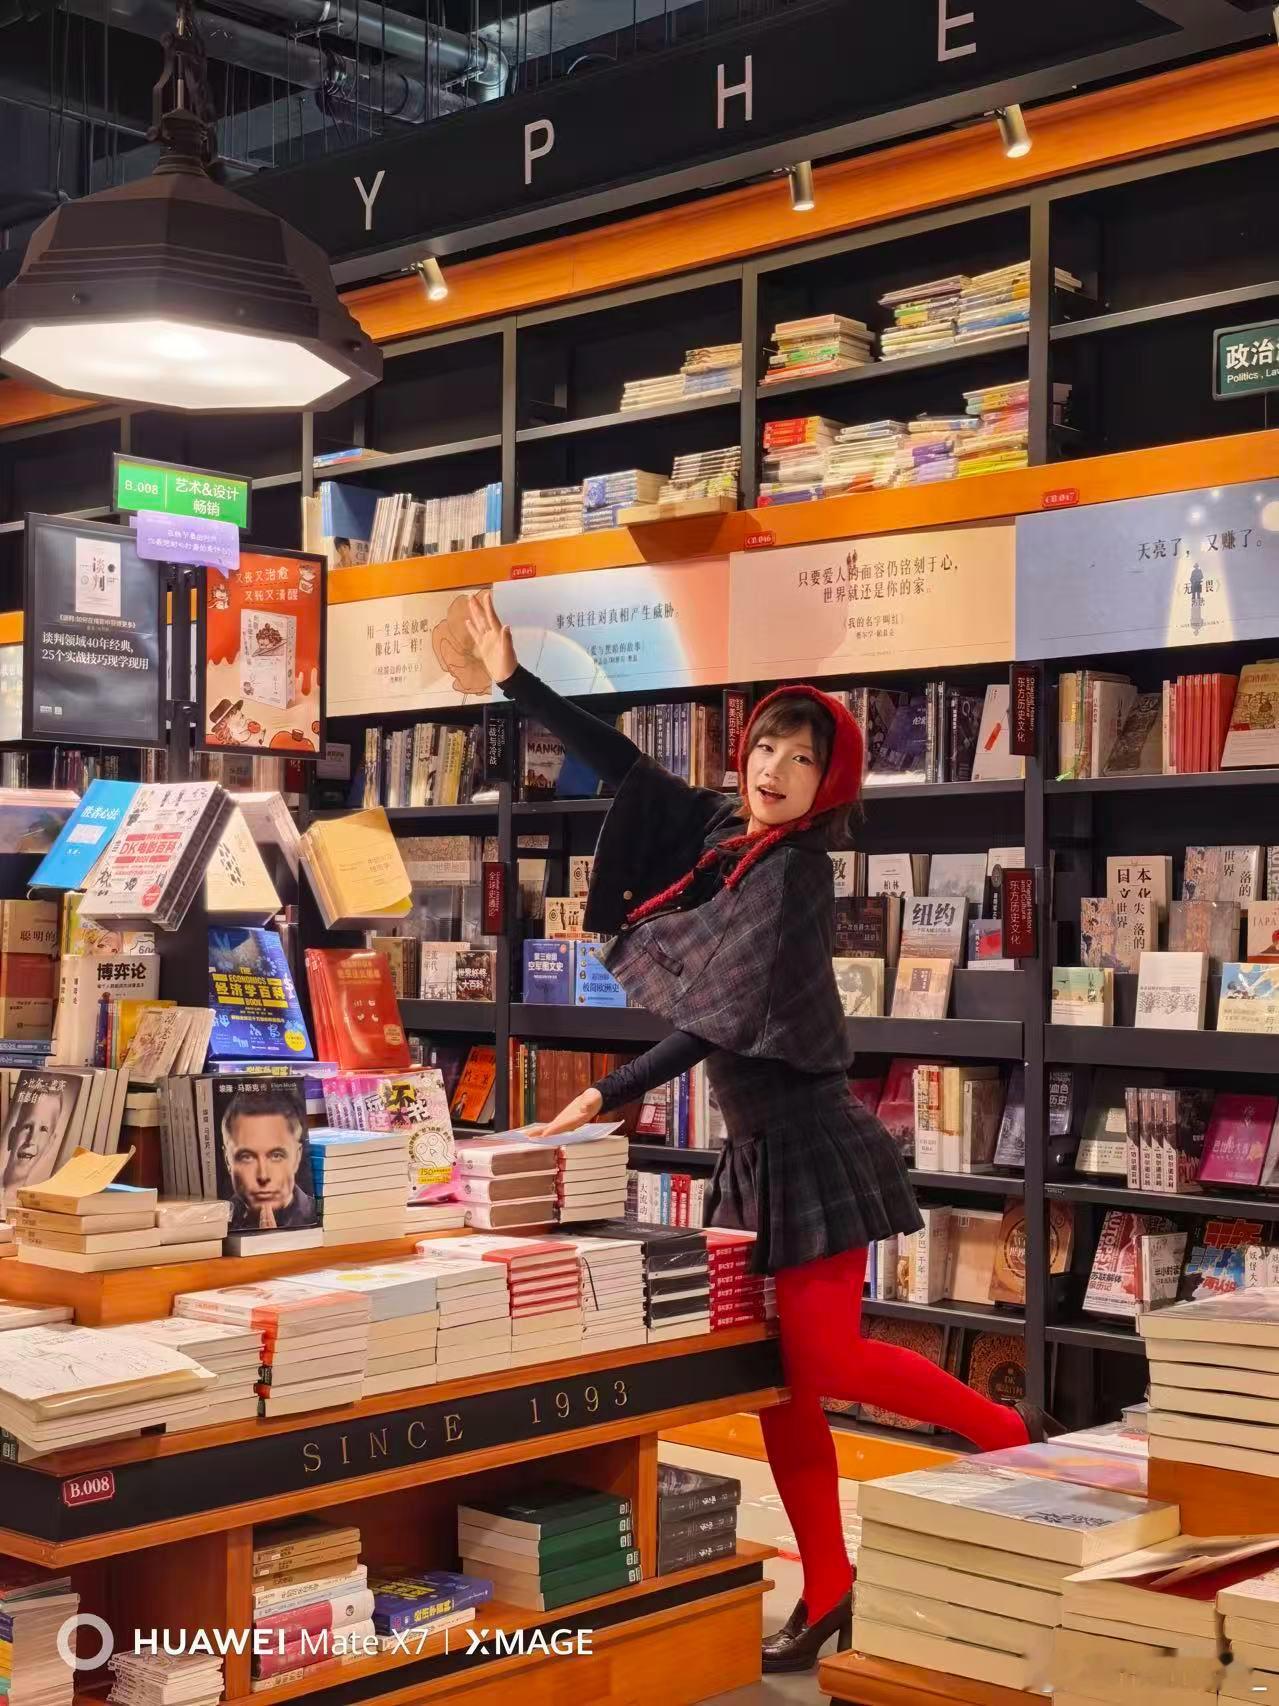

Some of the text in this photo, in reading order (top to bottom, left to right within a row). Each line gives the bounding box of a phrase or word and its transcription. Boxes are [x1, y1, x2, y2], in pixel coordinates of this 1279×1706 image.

[1226, 338, 1279, 369] 政治
[1266, 367, 1279, 377] La
[124, 479, 158, 495] B.008
[175, 477, 239, 501] 艺术&设计
[193, 499, 220, 516] 畅销
[93, 557, 105, 592] 谈判
[42, 649, 149, 670] 25个实战技巧现学现用
[1017, 677, 1025, 742] 东方历史文化
[119, 840, 177, 855] DK电影百科
[884, 880, 900, 890] 柏林
[912, 903, 956, 927] 纽约
[1010, 880, 1021, 945] 东方历史文化
[1117, 902, 1128, 929] 世界
[20, 929, 57, 943] 聪明的
[1133, 902, 1146, 950] 失落的
[97, 962, 147, 981] 博弈论
[215, 981, 286, 1000] 经济学百科
[302, 1380, 630, 1474] SINCE 1993
[70, 1475, 110, 1500] B.008
